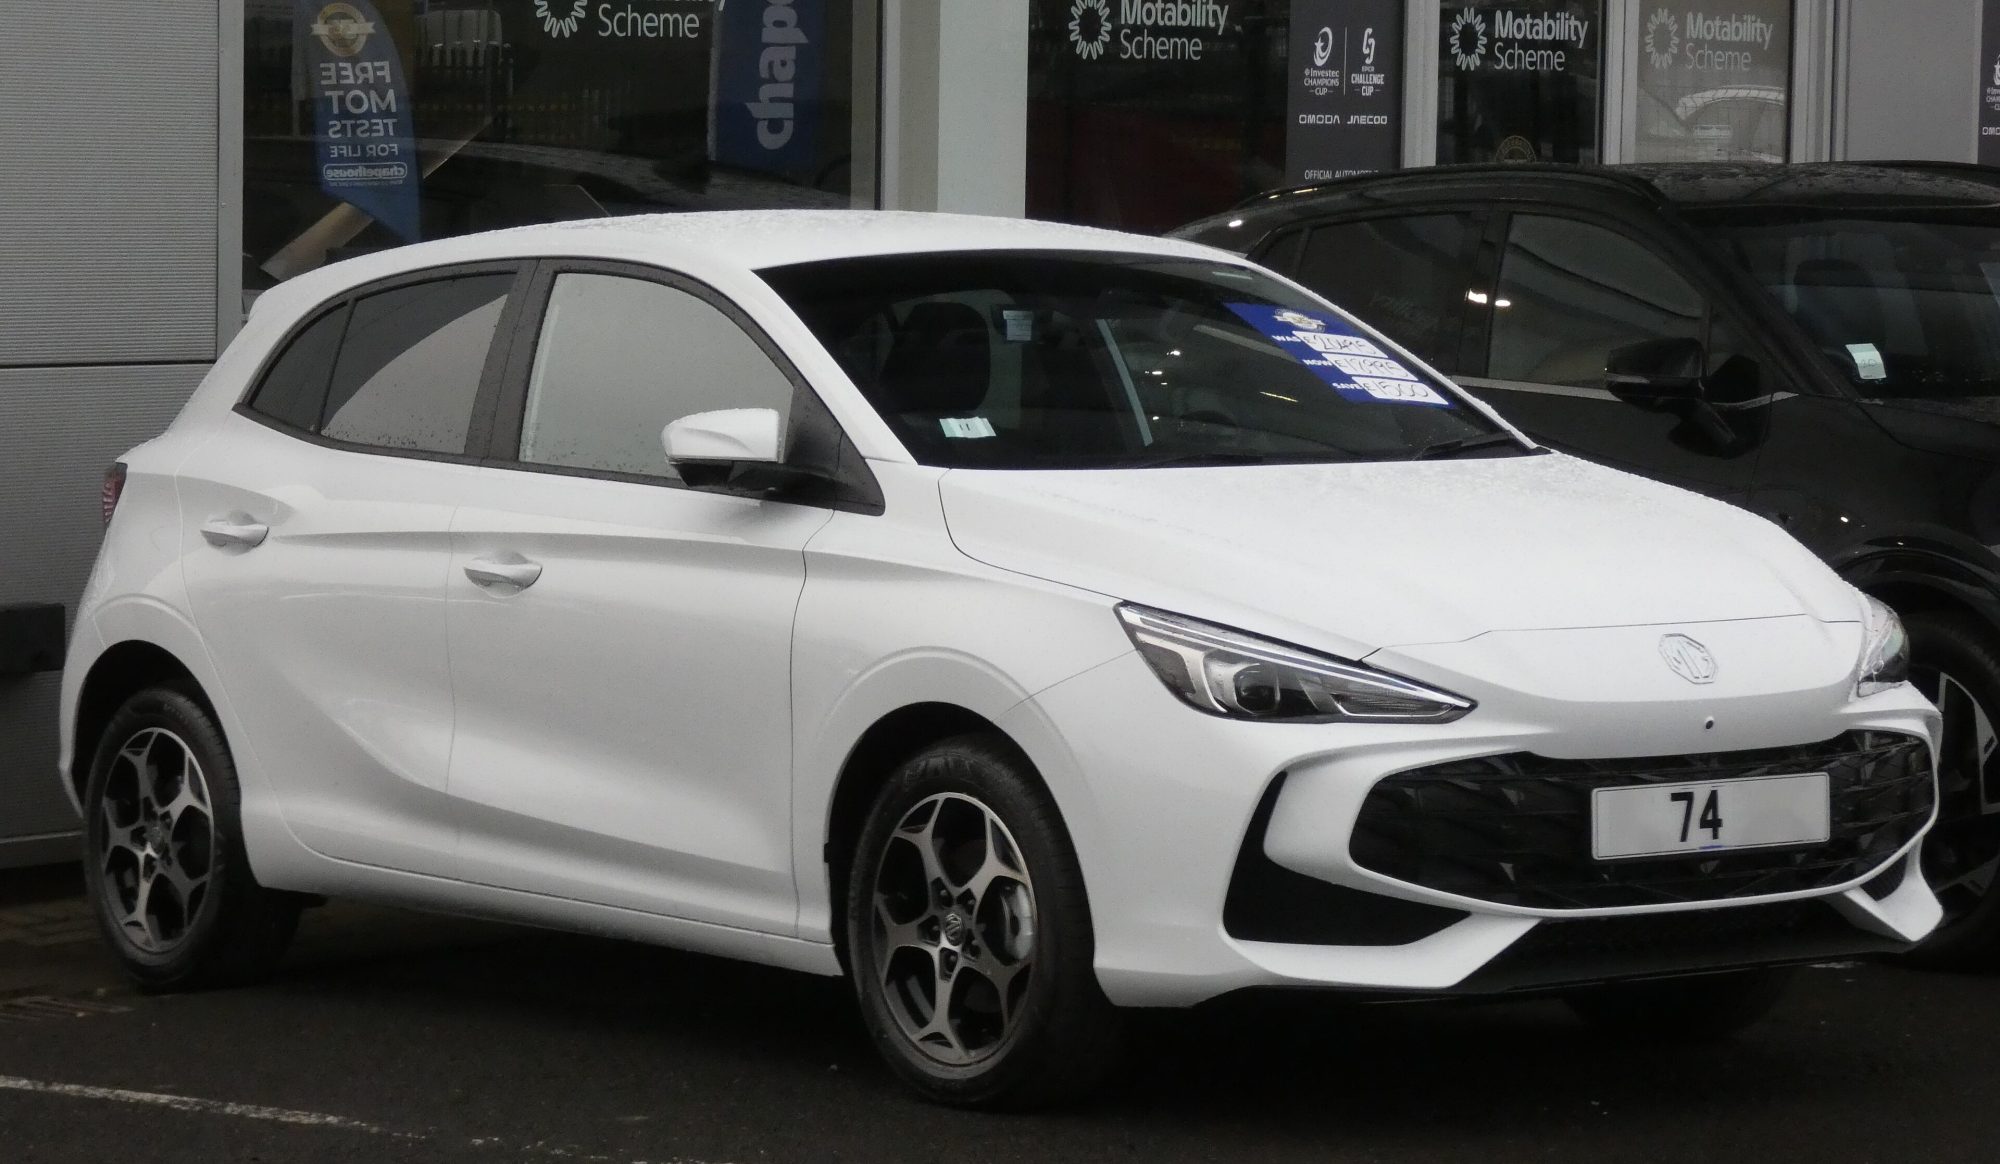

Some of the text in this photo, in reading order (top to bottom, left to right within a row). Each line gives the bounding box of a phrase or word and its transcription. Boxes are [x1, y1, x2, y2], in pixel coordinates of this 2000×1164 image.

[598, 3, 700, 38] Scheme
[1120, 0, 1229, 35] Motability
[1494, 9, 1589, 49] Motability
[1686, 11, 1773, 51] Motability
[1119, 28, 1203, 60] Scheme
[1494, 42, 1566, 71] Scheme
[1685, 42, 1752, 71] Scheme
[744, 0, 809, 150] chap
[1303, 78, 1340, 87] CHAMPIONS
[1310, 67, 1340, 77] Investec
[1351, 73, 1385, 85] CHALLENGE
[1314, 87, 1328, 96] CUP
[1361, 86, 1374, 96] CUP
[1298, 114, 1388, 125] OMODA JAECOO
[1304, 169, 1332, 180] OFFICIAL
[1332, 382, 1364, 390] SAVE
[1670, 789, 1723, 842] 74
